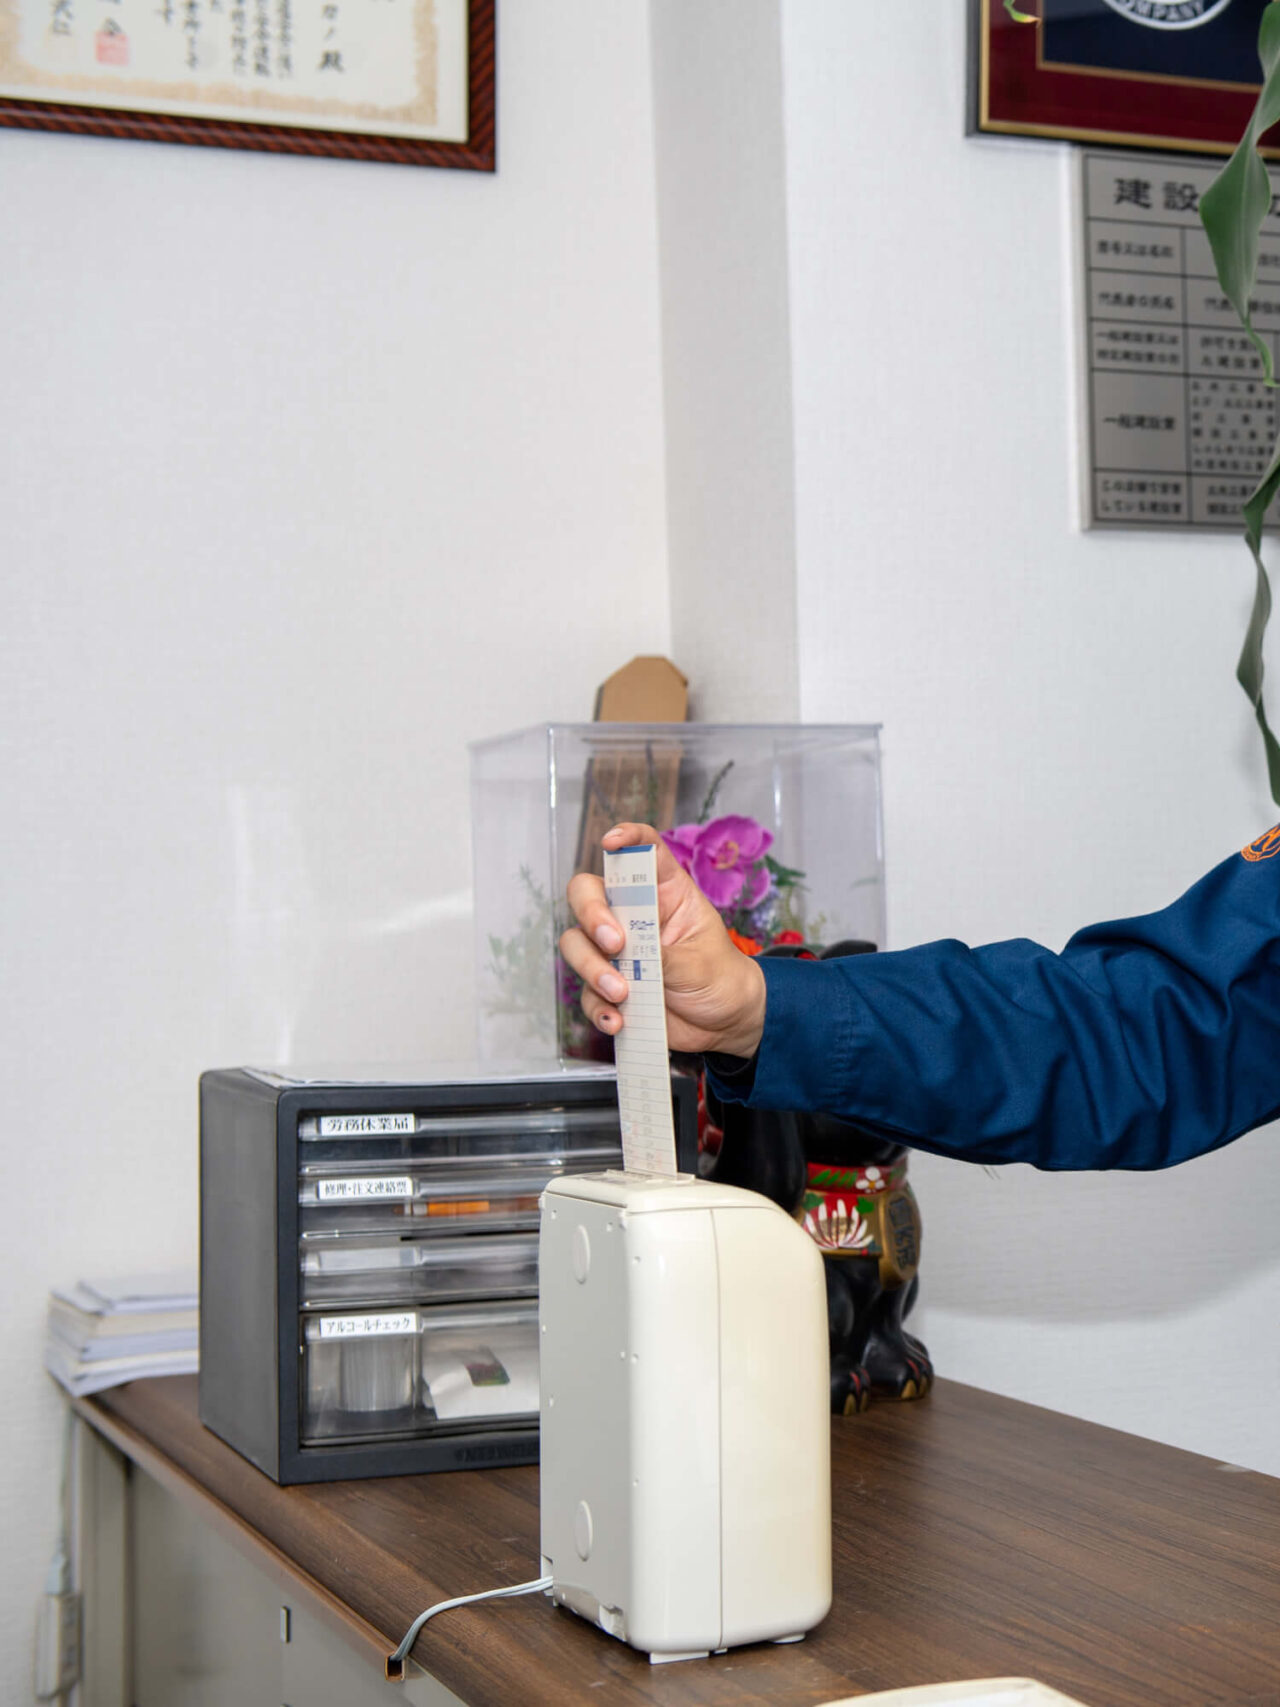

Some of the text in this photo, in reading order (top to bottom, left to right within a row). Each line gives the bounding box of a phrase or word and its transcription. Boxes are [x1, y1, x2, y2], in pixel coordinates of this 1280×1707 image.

[326, 1315, 411, 1335] アルコールチェック
